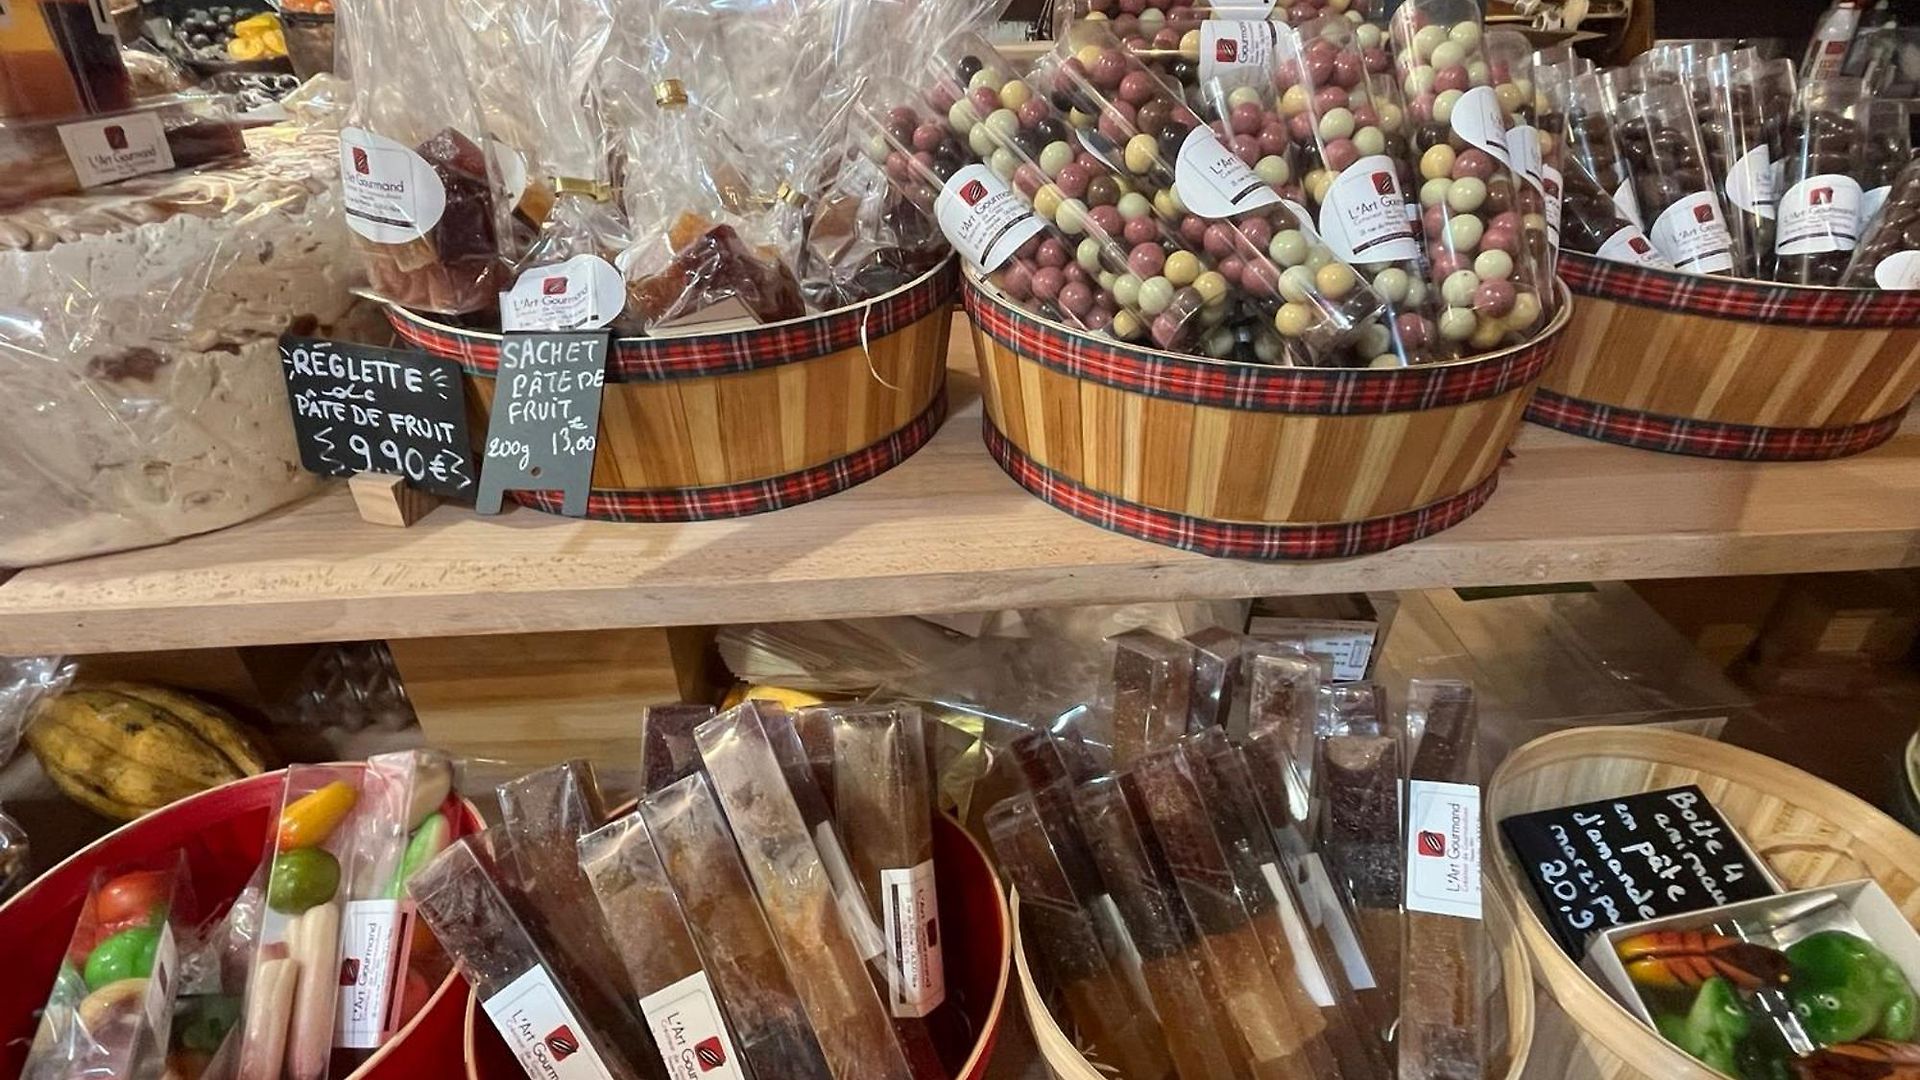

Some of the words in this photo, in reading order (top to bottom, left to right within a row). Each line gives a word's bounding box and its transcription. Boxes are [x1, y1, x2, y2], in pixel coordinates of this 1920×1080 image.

[1348, 201, 1378, 220] L'Art
[513, 297, 538, 312] L'Art
[503, 338, 599, 369] SACHET
[577, 369, 605, 390] DE
[294, 388, 346, 422] PÂTE
[350, 403, 383, 427] DE
[388, 412, 455, 444] FRUIT
[487, 437, 530, 470] 200g
[1447, 802, 1461, 860] Gourmand
[1446, 862, 1461, 892] L'Art
[358, 922, 377, 987] Gourmand
[511, 1008, 536, 1042] L'Art
[667, 1011, 687, 1046] L'Art
